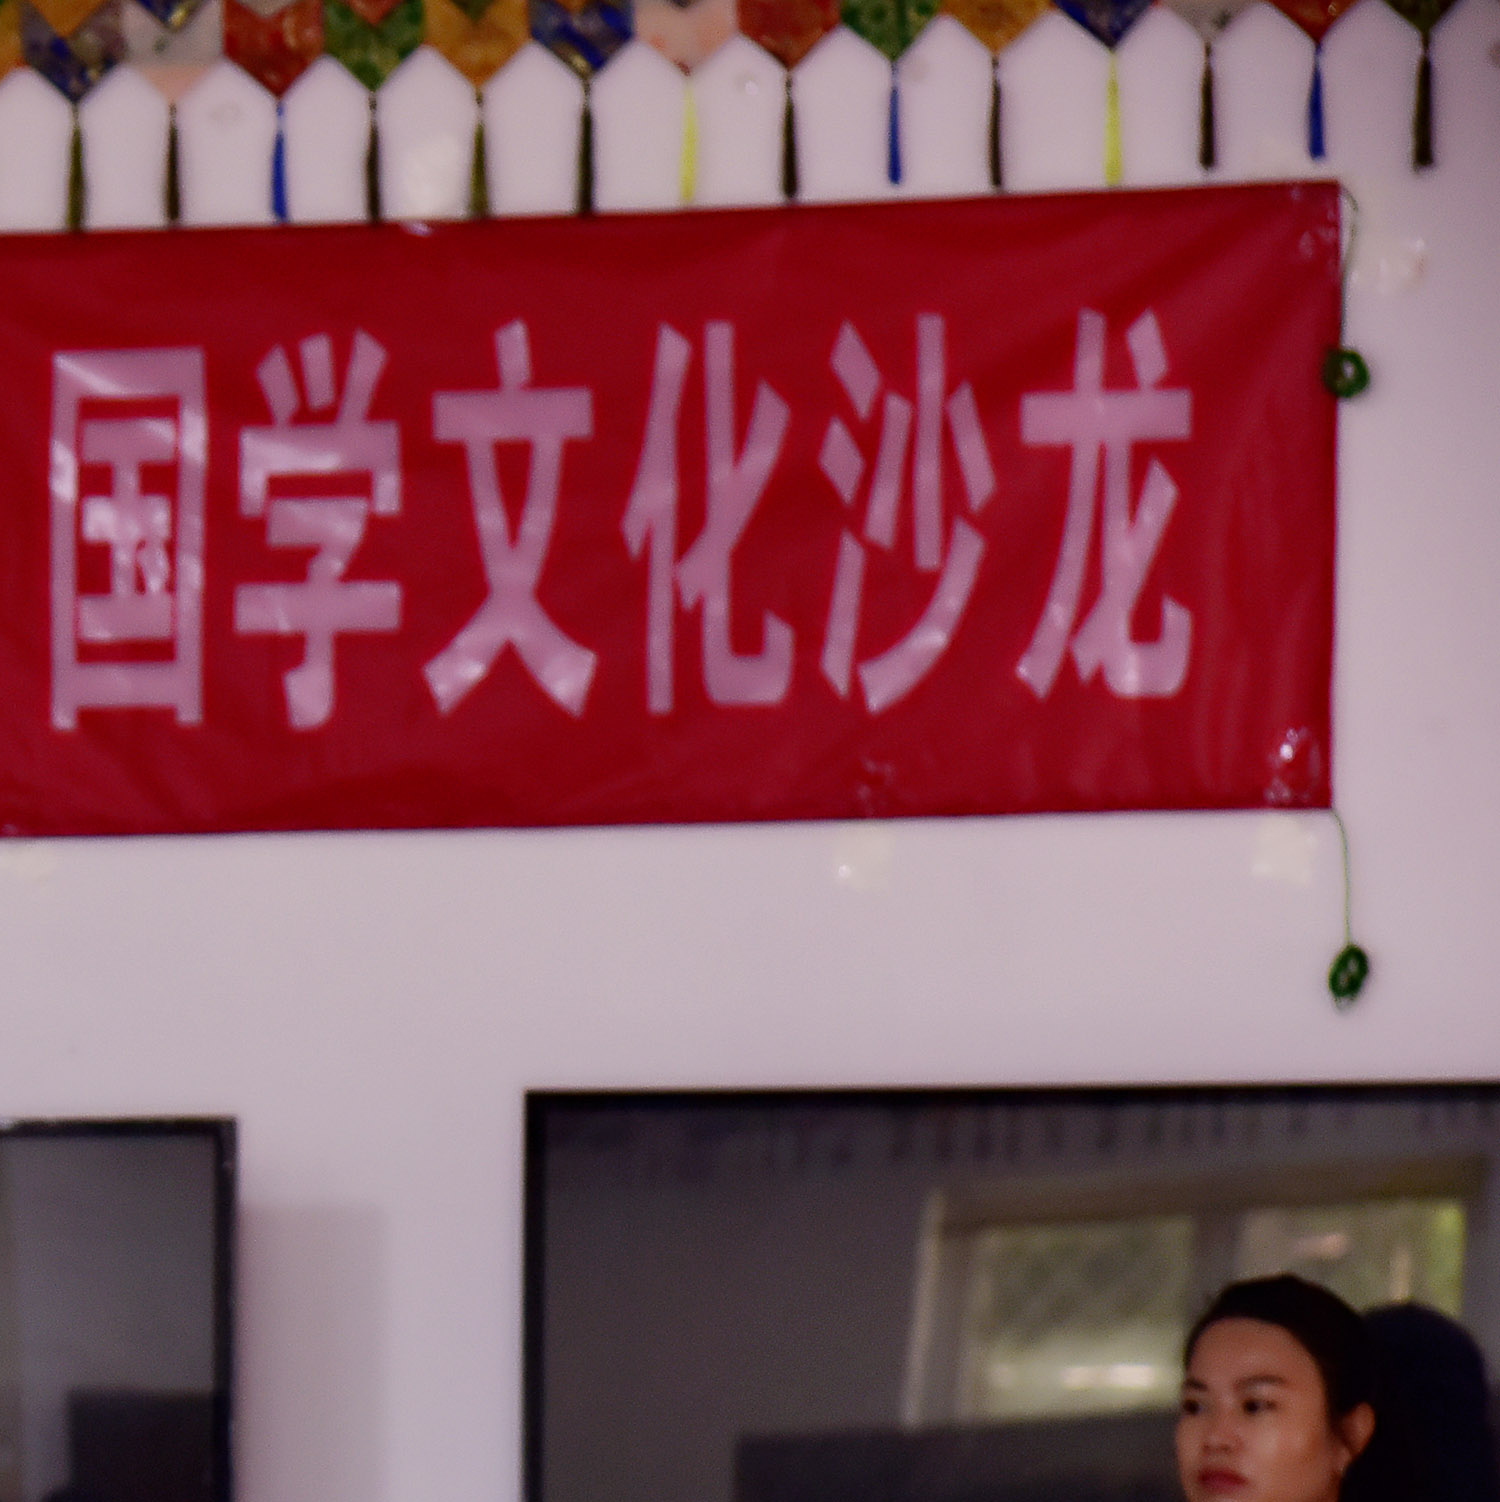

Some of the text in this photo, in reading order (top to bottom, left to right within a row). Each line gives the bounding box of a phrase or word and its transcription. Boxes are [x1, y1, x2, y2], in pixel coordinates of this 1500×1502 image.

[50, 307, 1195, 731] 国学文化沙龙
